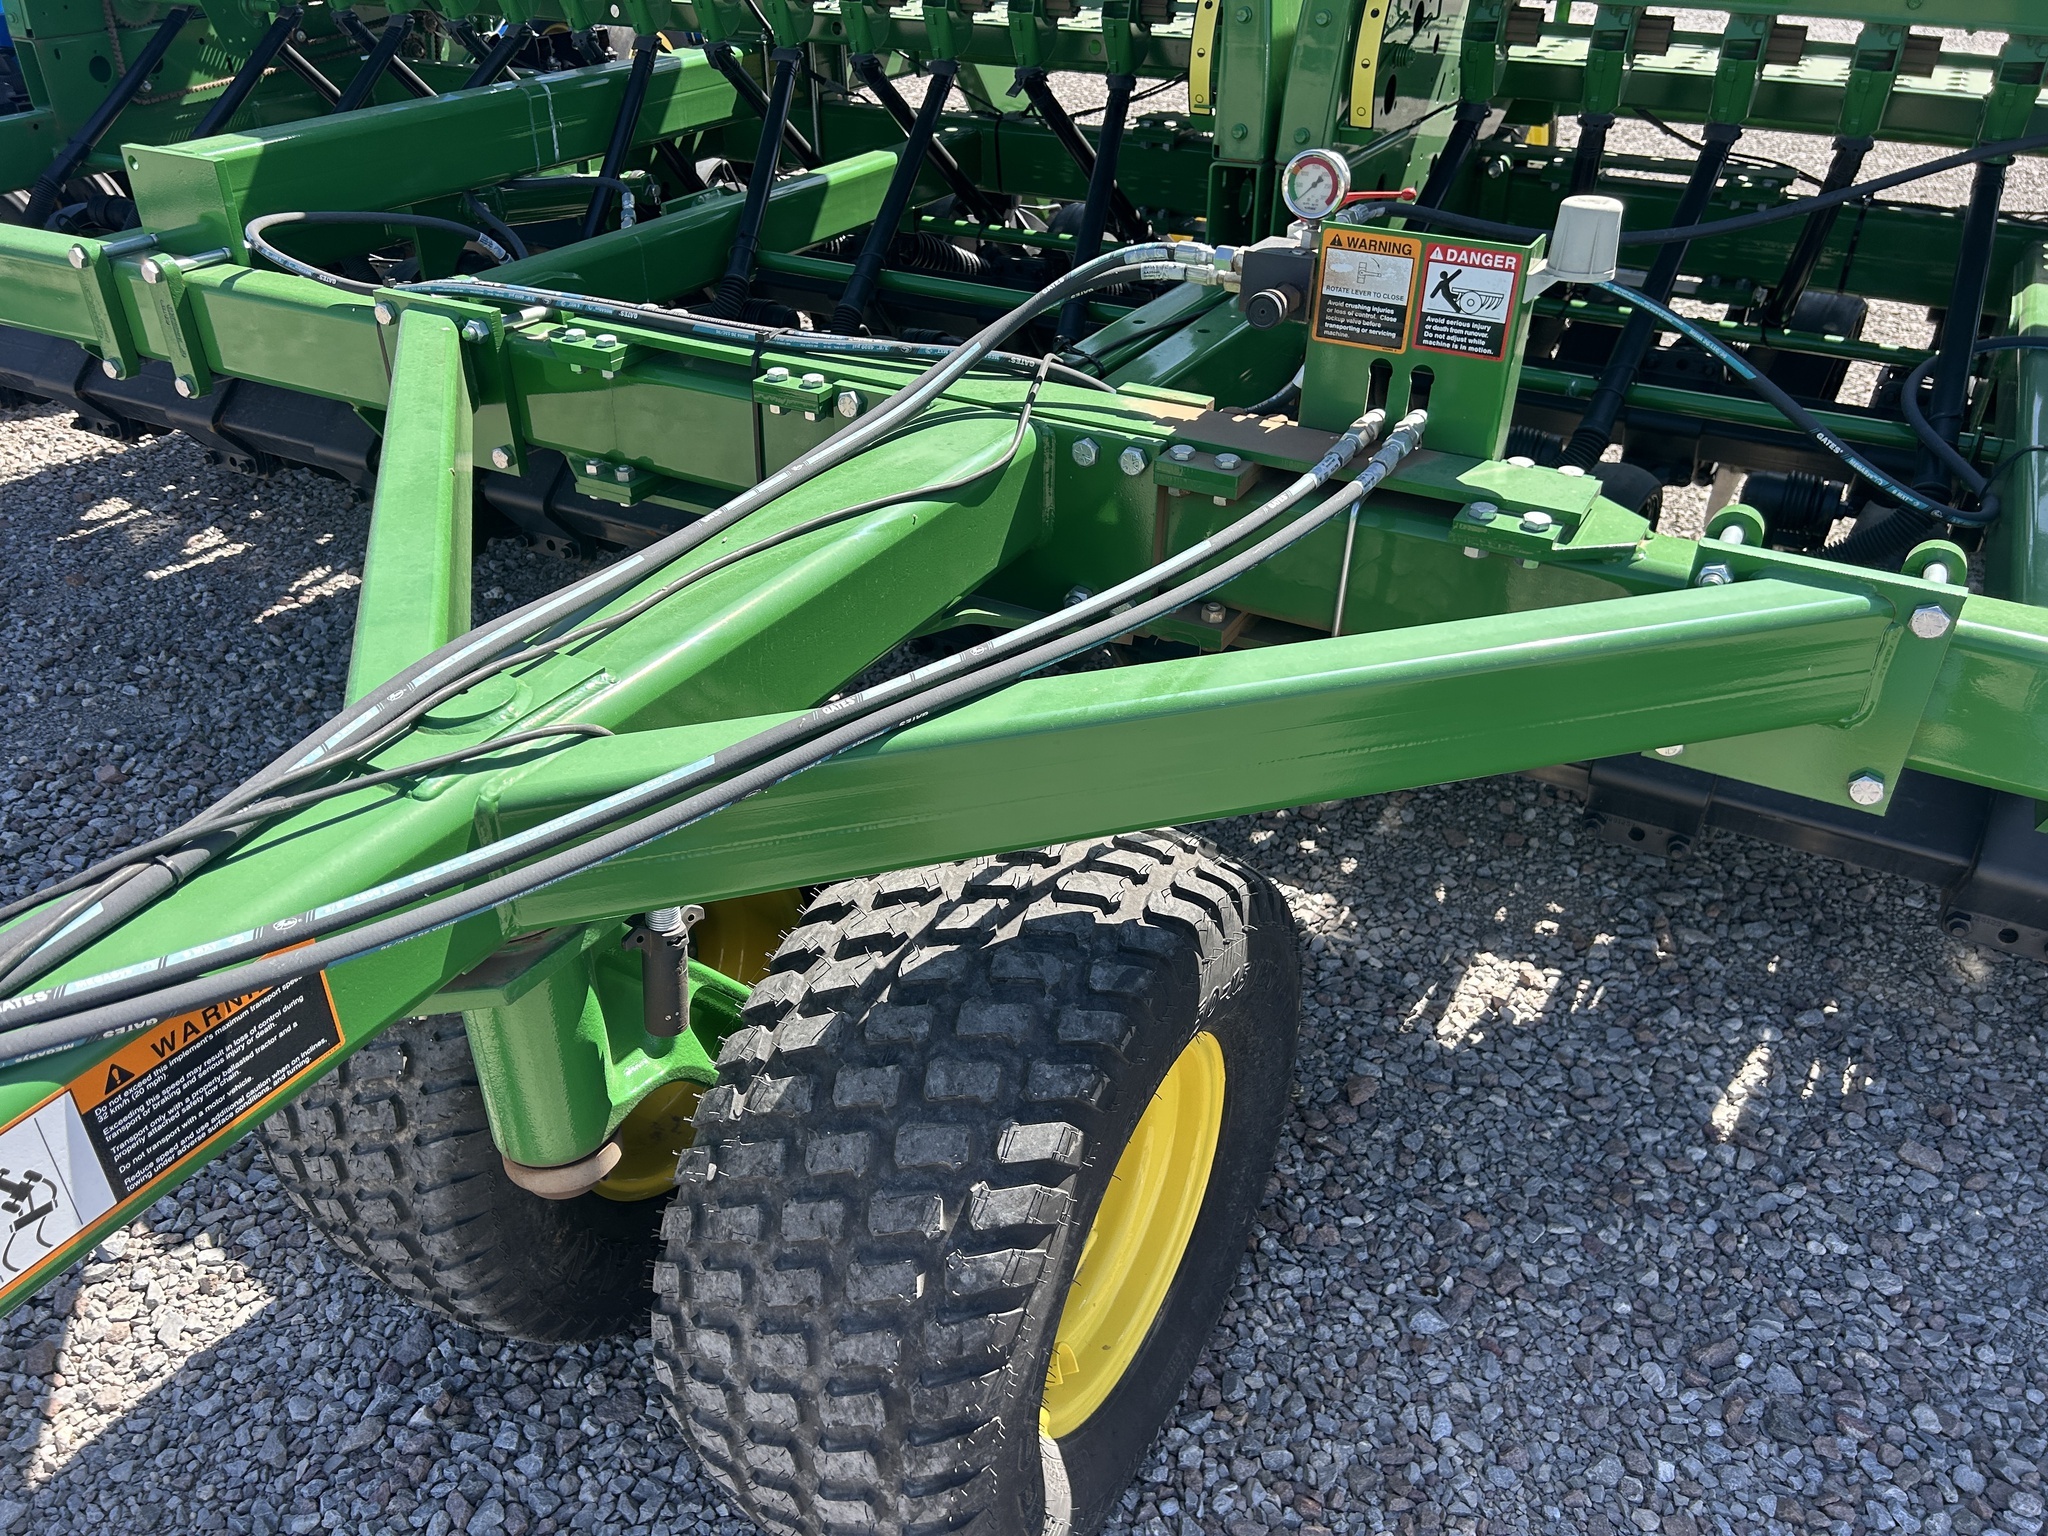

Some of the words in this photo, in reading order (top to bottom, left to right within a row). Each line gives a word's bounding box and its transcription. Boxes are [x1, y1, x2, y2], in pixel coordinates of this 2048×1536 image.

[1347, 237, 1412, 255] WARNING
[1446, 249, 1516, 269] DANGER
[1326, 285, 1349, 293] ROTATE
[1382, 293, 1404, 301] CLOSE
[618, 311, 639, 319] GATES
[1345, 303, 1371, 312] crushing
[1355, 312, 1377, 320] control.
[1326, 315, 1345, 323] lockup
[1426, 316, 1445, 324] Avoid
[1446, 319, 1471, 327] serious
[1472, 322, 1491, 331] injury
[1324, 330, 1349, 338] machine.
[1325, 322, 1360, 333] transporting
[1369, 328, 1396, 338] servicing
[1446, 334, 1467, 343] adjust
[1450, 327, 1463, 335] from
[1465, 330, 1488, 338] runover.
[1422, 340, 1451, 348] machine
[1467, 345, 1493, 354] motion.
[1009, 356, 1036, 368] GATES
[1816, 432, 1842, 454] GATES
[1848, 457, 1874, 479] MEGASys
[821, 698, 855, 716] GATES
[0, 990, 49, 1013] ATES
[102, 1017, 158, 1039] GATES
[94, 1106, 107, 1116] Do
[109, 1096, 123, 1108] not
[124, 1074, 152, 1098] exceed
[154, 1065, 168, 1079] this
[169, 1034, 214, 1069] implement's
[215, 1010, 250, 1035] maximum
[250, 987, 281, 1012] transport
[103, 1104, 145, 1136] Exceeding
[146, 1093, 161, 1109] this
[161, 1077, 185, 1101] speed
[185, 1065, 203, 1084] may
[204, 1050, 224, 1068] result
[225, 1044, 233, 1053] in
[233, 1033, 249, 1046] loss
[250, 1026, 257, 1035] of
[258, 1011, 282, 1030] control
[282, 995, 304, 1013] during
[105, 1113, 142, 1142] transport
[142, 1106, 152, 1117] or
[152, 1091, 181, 1110] braking
[182, 1077, 197, 1090] and
[198, 1059, 225, 1078] serious
[225, 1042, 245, 1060] injury
[246, 1036, 255, 1045] or
[255, 1023, 278, 1039] death.
[110, 1121, 149, 1154] Transport
[149, 1113, 167, 1129] only
[167, 1101, 184, 1115] with
[191, 1075, 221, 1098] properly
[222, 1052, 254, 1076] ballasted
[255, 1035, 278, 1055] tractor
[278, 1026, 292, 1038] and
[97, 1113, 109, 1123] 32
[110, 1098, 130, 1116] km/h
[132, 1089, 145, 1103] (20
[147, 1074, 169, 1095] mph).
[114, 1134, 146, 1162] properly
[147, 1111, 181, 1138] attached
[181, 1095, 204, 1114] safety
[205, 1085, 218, 1097] tow
[219, 1070, 242, 1087] chain.
[123, 1160, 154, 1186] Reduce
[155, 1142, 179, 1167] speed
[180, 1131, 195, 1143] and
[195, 1123, 210, 1134] use
[210, 1095, 245, 1124] additional
[245, 1078, 271, 1097] caution
[272, 1064, 290, 1081] when
[290, 1055, 300, 1066] on
[300, 1038, 328, 1059] inclines,
[118, 1162, 131, 1174] Do
[132, 1151, 146, 1164] not
[146, 1126, 182, 1155] transport
[181, 1115, 197, 1129] with
[204, 1094, 226, 1112] motor
[227, 1075, 254, 1097] vehicle.
[126, 1169, 153, 1192] towing
[153, 1153, 176, 1172] under
[177, 1131, 207, 1155] adverse
[207, 1112, 234, 1134] surface
[235, 1086, 272, 1115] conditions,
[272, 1074, 286, 1086] and
[287, 1057, 312, 1077] turning.
